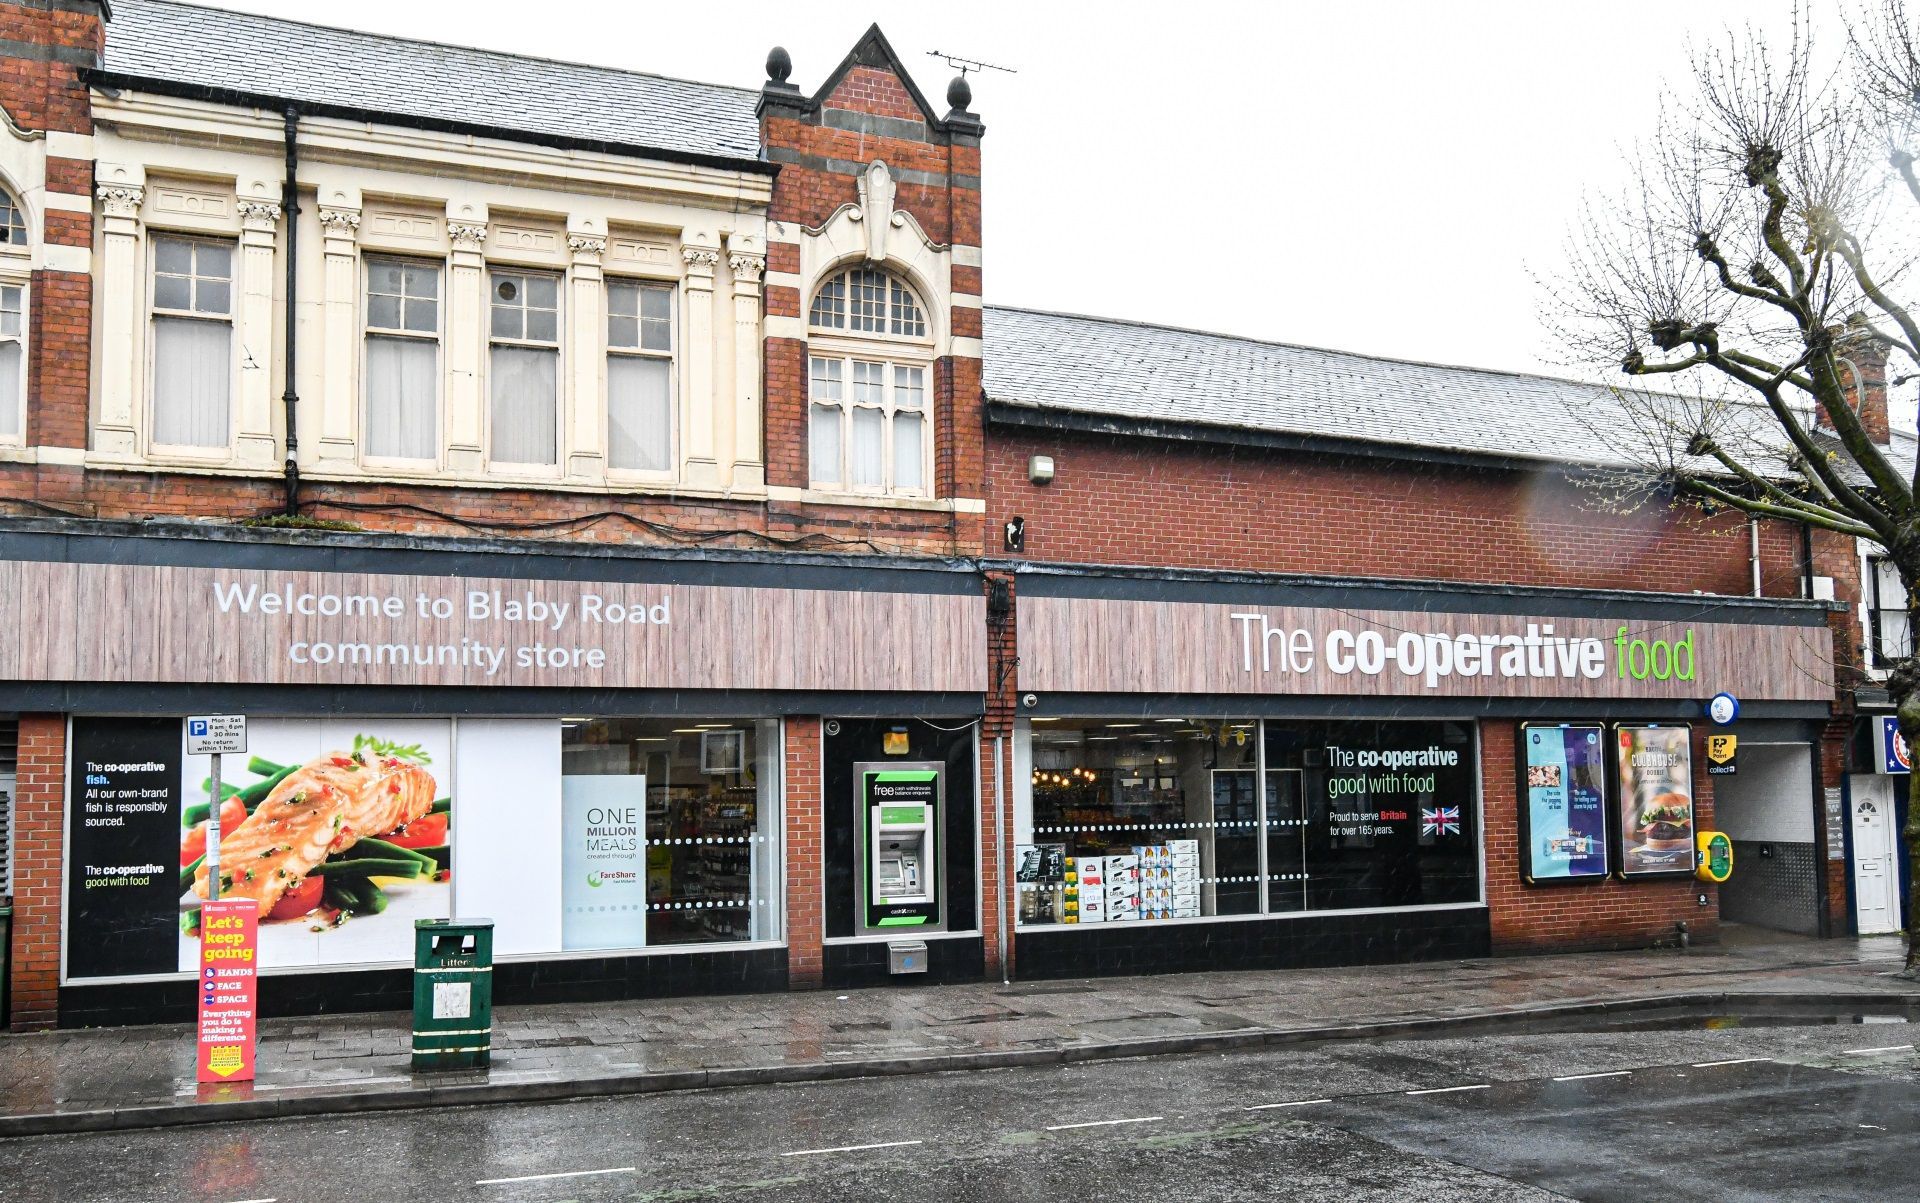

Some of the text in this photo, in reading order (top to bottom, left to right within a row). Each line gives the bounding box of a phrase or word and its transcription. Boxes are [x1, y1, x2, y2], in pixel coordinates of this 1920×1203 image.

[213, 582, 671, 630] Welcome to Blaby Road
[289, 637, 606, 675] community store
[1230, 613, 1695, 688] The co-operative food
[193, 722, 205, 735] P
[1326, 746, 1458, 771] The co-operative
[86, 762, 165, 774] The co-operative
[86, 775, 110, 784] fish.
[1329, 772, 1435, 799] good with food
[85, 788, 168, 798] All our own-brand
[874, 784, 895, 796] free
[85, 801, 168, 814] fish is responsibly
[85, 816, 125, 827] sourced.
[587, 808, 637, 825] ONE
[1329, 810, 1407, 822] Proud to serve Britain
[587, 827, 637, 837] MILLION
[1330, 825, 1395, 837] for over 165 years.
[587, 838, 637, 851] MEALS
[85, 864, 165, 876] The co-operative
[600, 871, 636, 879] FareShare
[85, 876, 150, 889] good with food
[206, 915, 244, 929] Let's
[205, 931, 245, 947] keep
[204, 946, 254, 963] going
[440, 958, 467, 967] Litter
[217, 968, 253, 977] HANDS
[217, 982, 242, 990] FACE
[217, 995, 248, 1004] SPACE
[202, 1009, 252, 1018] Everything
